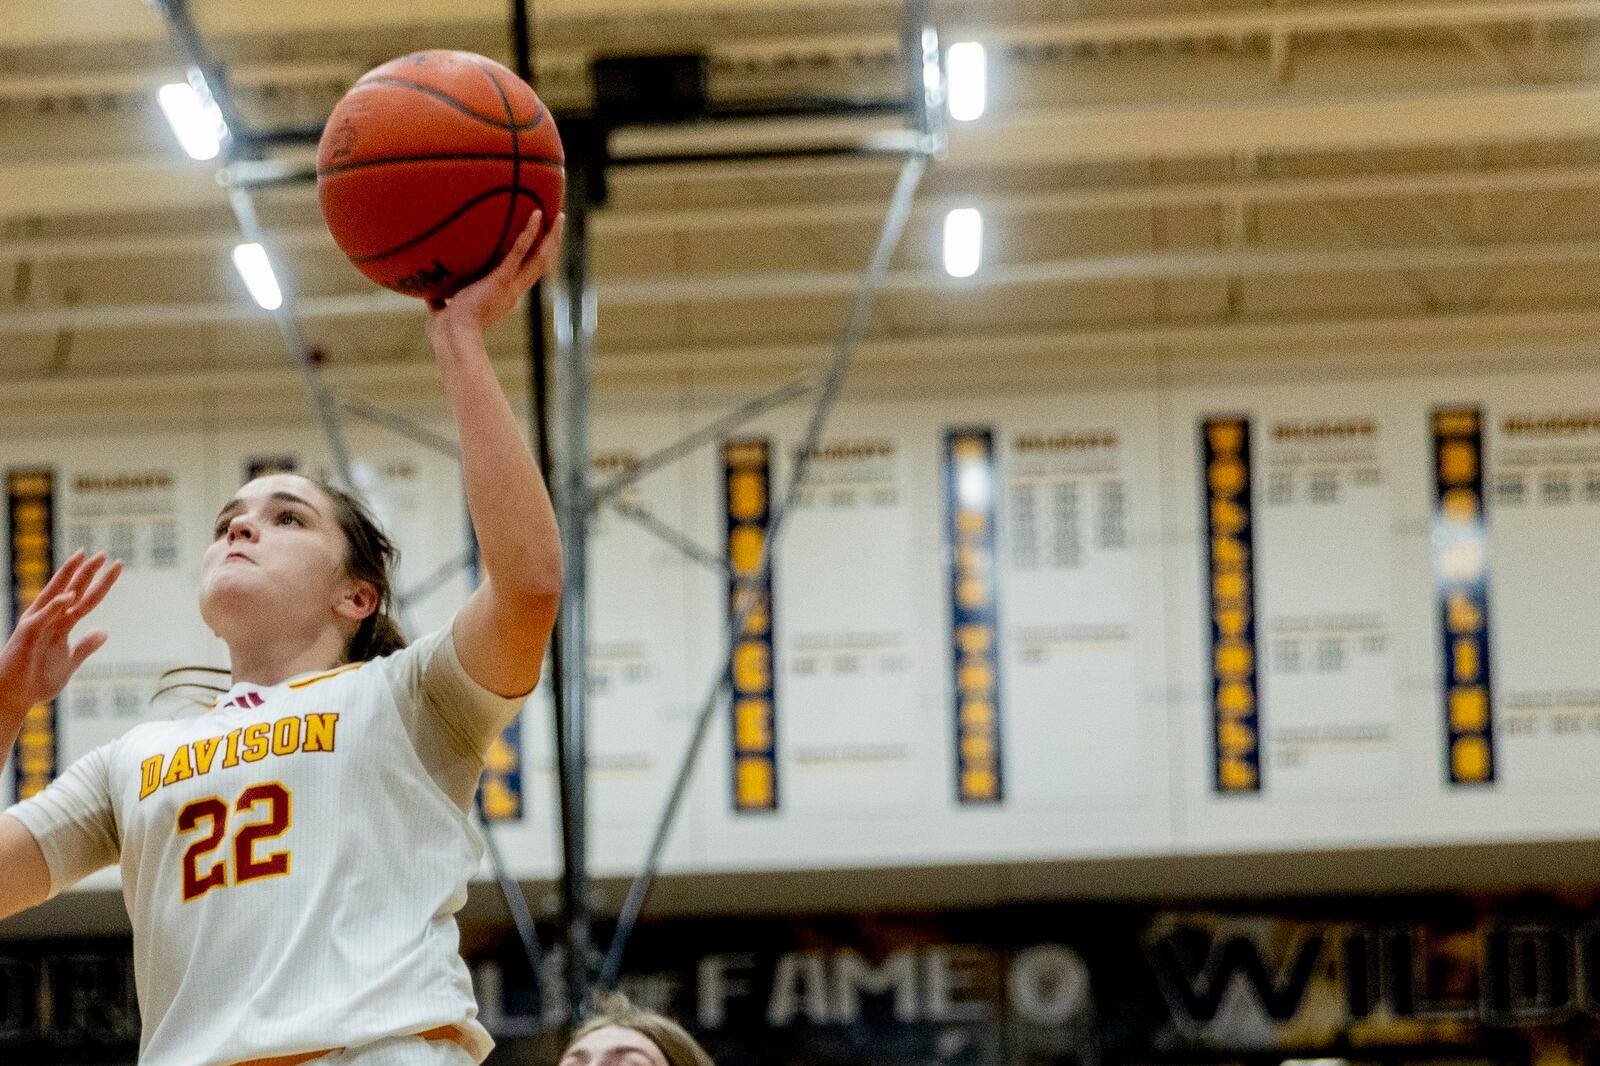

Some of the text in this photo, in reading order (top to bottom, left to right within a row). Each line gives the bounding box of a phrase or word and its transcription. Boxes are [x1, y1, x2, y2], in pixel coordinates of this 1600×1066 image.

[139, 712, 339, 801] DAVISON
[175, 780, 293, 903] 22
[698, 946, 993, 1029] FAME
[1140, 912, 1600, 1050] WILD
